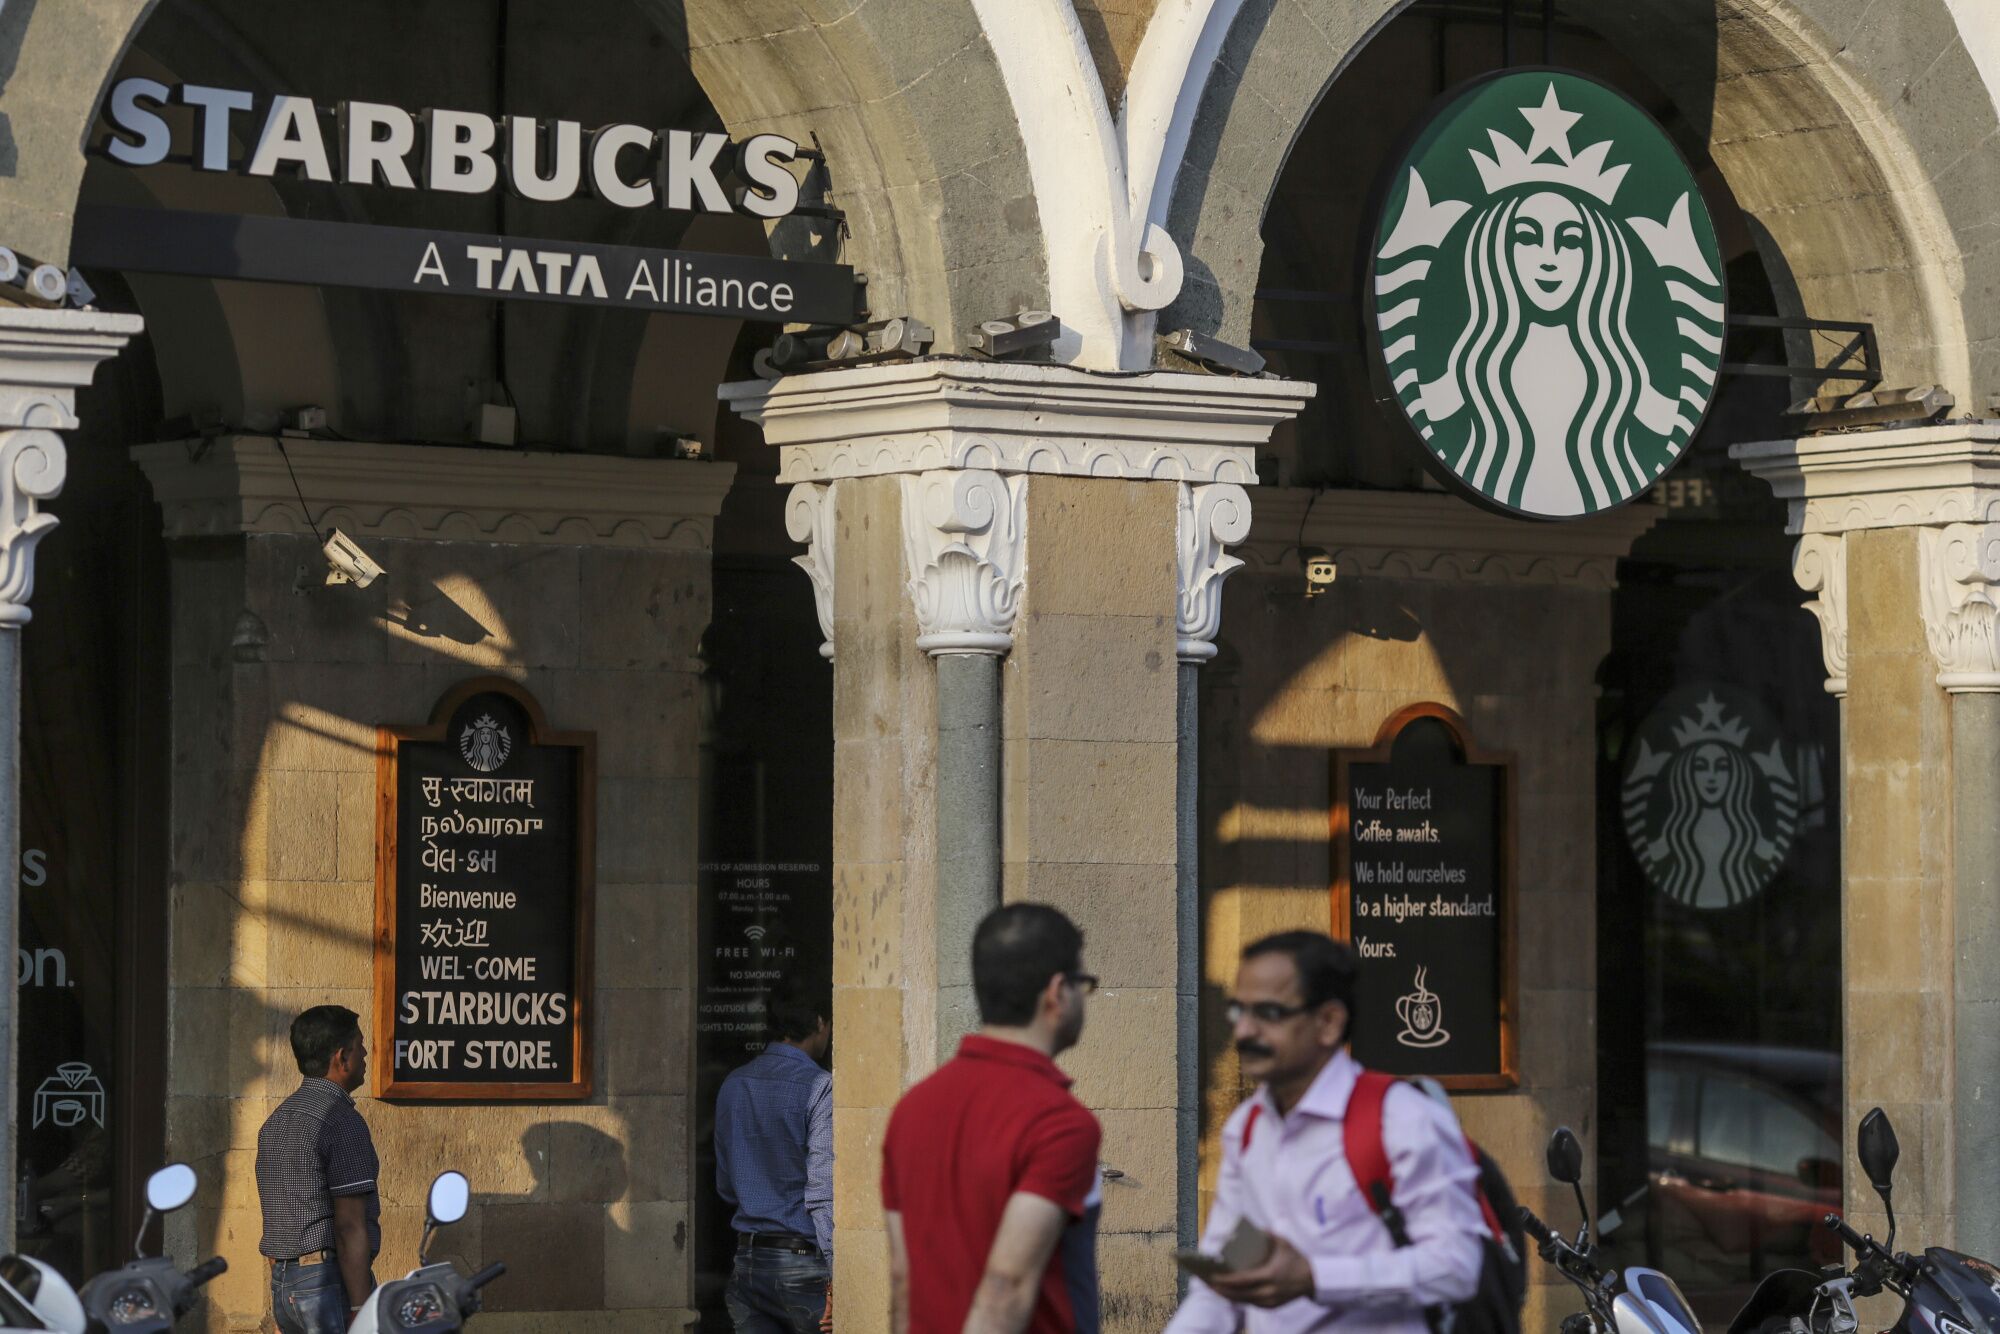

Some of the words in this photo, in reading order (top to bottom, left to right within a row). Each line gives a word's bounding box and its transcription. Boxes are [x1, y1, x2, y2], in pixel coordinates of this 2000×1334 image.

[107, 77, 801, 218] STARBUCKS
[412, 241, 450, 287] A
[466, 244, 609, 299] TATA
[625, 257, 794, 312] Alliance
[1355, 787, 1382, 809] Your
[1386, 787, 1431, 810] Perfect
[1354, 820, 1393, 842] Coffee
[1396, 820, 1441, 843] awaits.
[736, 878, 770, 889] HOURS
[1355, 861, 1375, 883] We
[1377, 861, 1404, 884] hold
[1407, 861, 1466, 884] ourselves
[420, 883, 517, 910] Bienvenue
[1355, 895, 1369, 918] to
[1370, 902, 1382, 918] a
[1384, 894, 1427, 924] higher
[1429, 894, 1496, 918] standard.
[420, 917, 490, 948] 欢迎
[716, 948, 749, 958] FREE
[1355, 935, 1397, 959] Yours.
[420, 955, 537, 982] WEL-COME
[730, 971, 742, 980] NO
[744, 971, 781, 980] SMOKING
[399, 991, 567, 1026] STARBUCKS
[395, 1040, 455, 1070] FORT
[463, 1040, 558, 1070] STORE.
